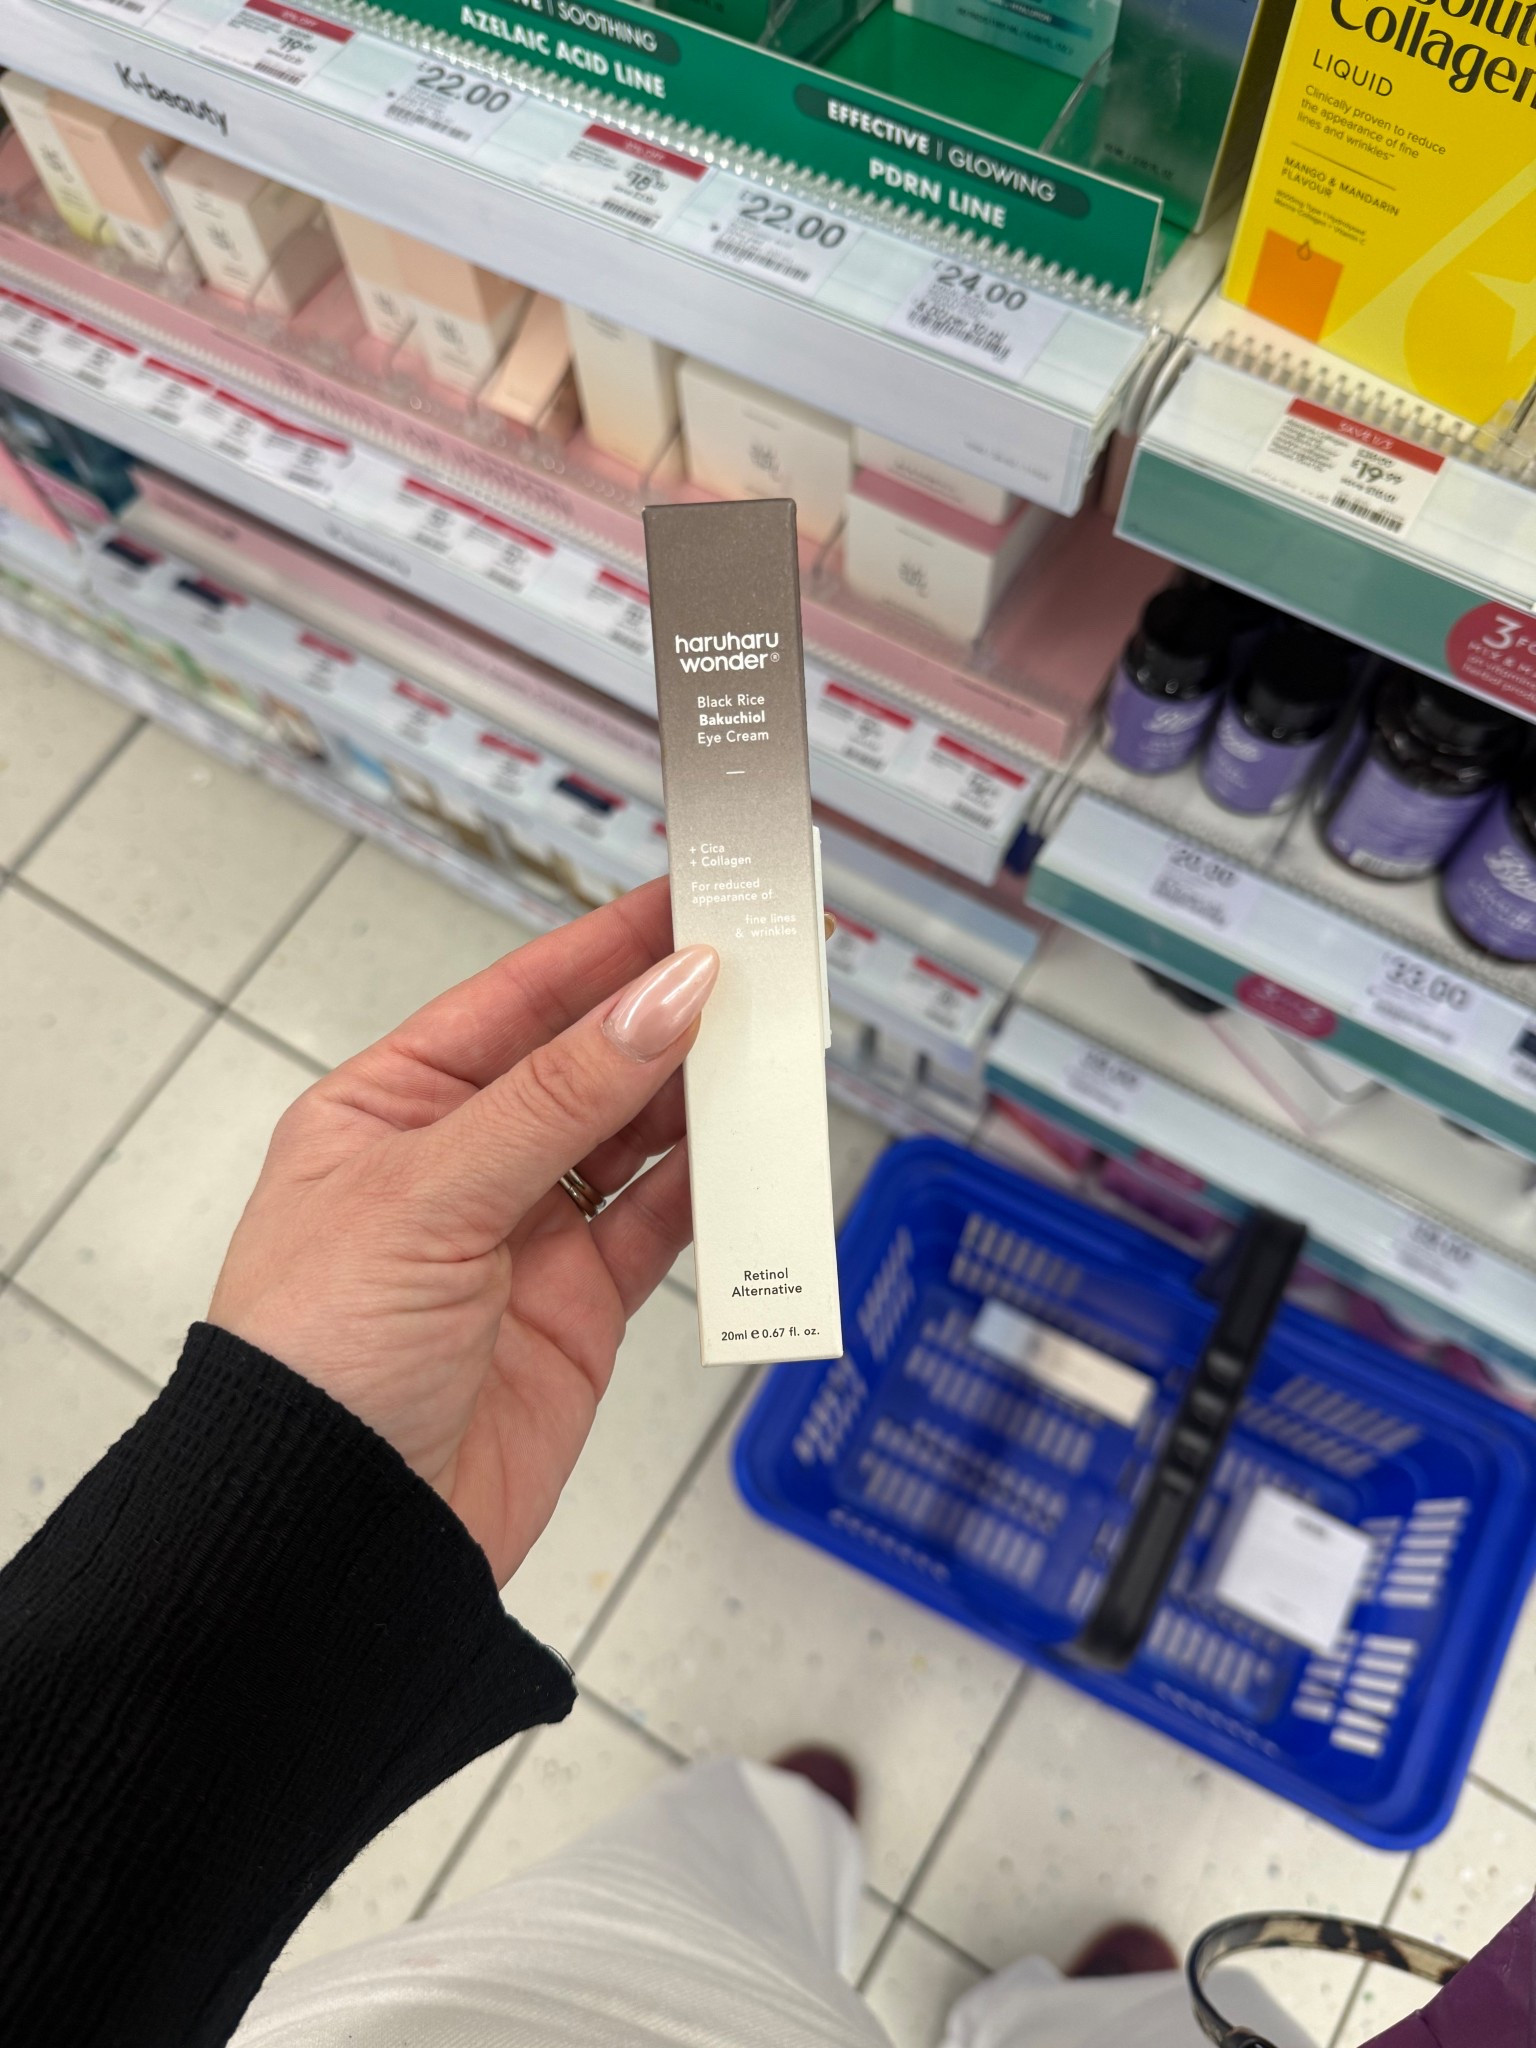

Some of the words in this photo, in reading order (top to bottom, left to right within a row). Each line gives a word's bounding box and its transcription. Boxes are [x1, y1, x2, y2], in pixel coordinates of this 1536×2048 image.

[557, 0, 658, 52] SOOTHING
[460, 4, 551, 56] AZELAIC
[555, 39, 610, 76] ACID
[613, 60, 667, 99] LINE
[1312, 48, 1393, 97] LIQUID
[114, 61, 229, 138] K-beauty
[1296, 111, 1322, 131] lines
[1323, 125, 1345, 141] and
[1300, 98, 1320, 114] the
[1320, 108, 1384, 144] appearance
[1385, 137, 1399, 149] of
[1398, 142, 1420, 159] fine
[1305, 84, 1353, 115] Clinically
[1352, 107, 1392, 131] proven
[1393, 125, 1406, 138] to
[1407, 131, 1447, 156] reduce
[827, 99, 931, 156] EFFECTIVE
[948, 146, 1057, 203] GLOWING
[869, 156, 942, 204] PDRN
[948, 187, 1006, 229] LINE
[1281, 166, 1335, 199] FLAVOUR
[1284, 156, 1327, 183] MANGO
[1328, 177, 1338, 188] &
[1339, 181, 1400, 217] MANDARIN
[675, 631, 779, 654] haruharu
[1481, 614, 1524, 651] 3
[697, 694, 733, 709] Black
[737, 693, 766, 706] Rice
[699, 709, 766, 726] Bakuchiol
[697, 731, 722, 748] Eye
[726, 730, 769, 743] Cream
[700, 843, 725, 855] Cica
[701, 855, 752, 869] Collagen
[691, 881, 711, 893] For
[714, 876, 760, 891] reduced
[692, 892, 758, 907] appearance
[761, 888, 773, 900] of
[745, 913, 767, 925] fine
[770, 913, 797, 924] lines
[735, 927, 744, 938] &
[751, 924, 797, 938] wrinkles
[743, 1267, 789, 1282] Retinol
[731, 1283, 803, 1298] Alternative
[721, 1330, 748, 1341] 20ml
[762, 1327, 785, 1339] 0.67
[789, 1326, 800, 1338] fl.
[804, 1328, 820, 1337] oz.
